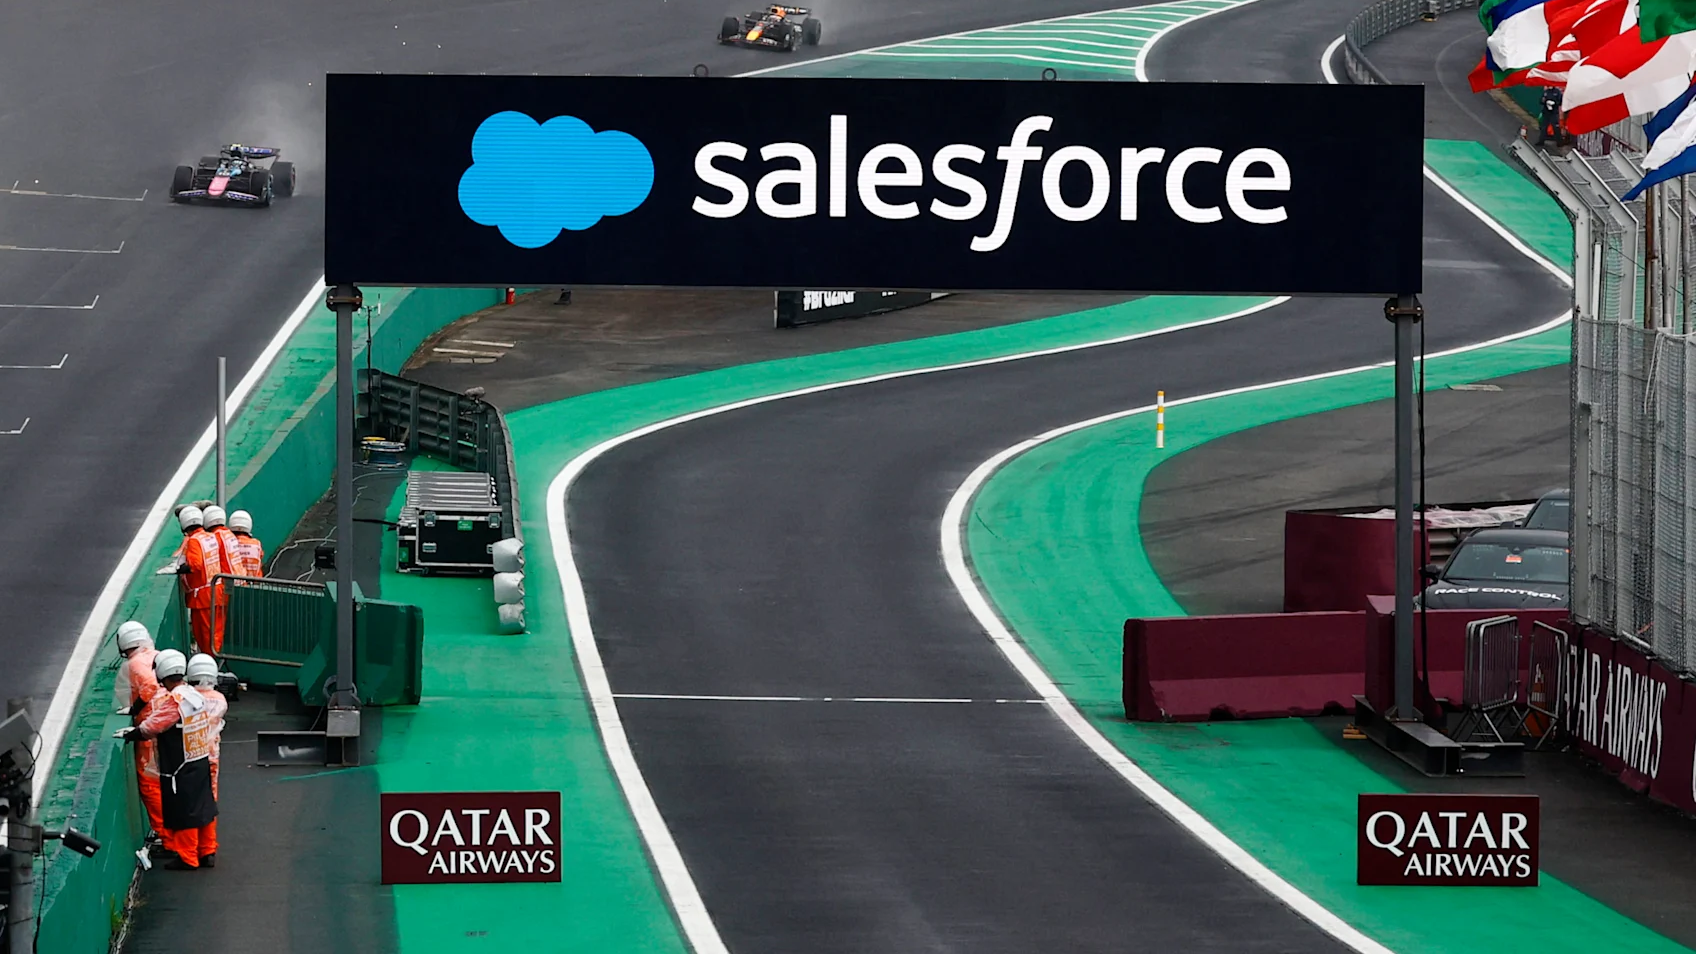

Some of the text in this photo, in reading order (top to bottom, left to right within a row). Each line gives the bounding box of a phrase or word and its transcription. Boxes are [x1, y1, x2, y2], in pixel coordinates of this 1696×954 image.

[692, 115, 1291, 252] salesforce
[1434, 587, 1562, 601] RACE CONTROL
[1601, 660, 1667, 779] AIRWAYS
[389, 809, 554, 855] QATAR
[1365, 811, 1530, 857] QATAR
[428, 850, 556, 874] AIRWAYS
[1404, 853, 1531, 878] AIRWAYS
